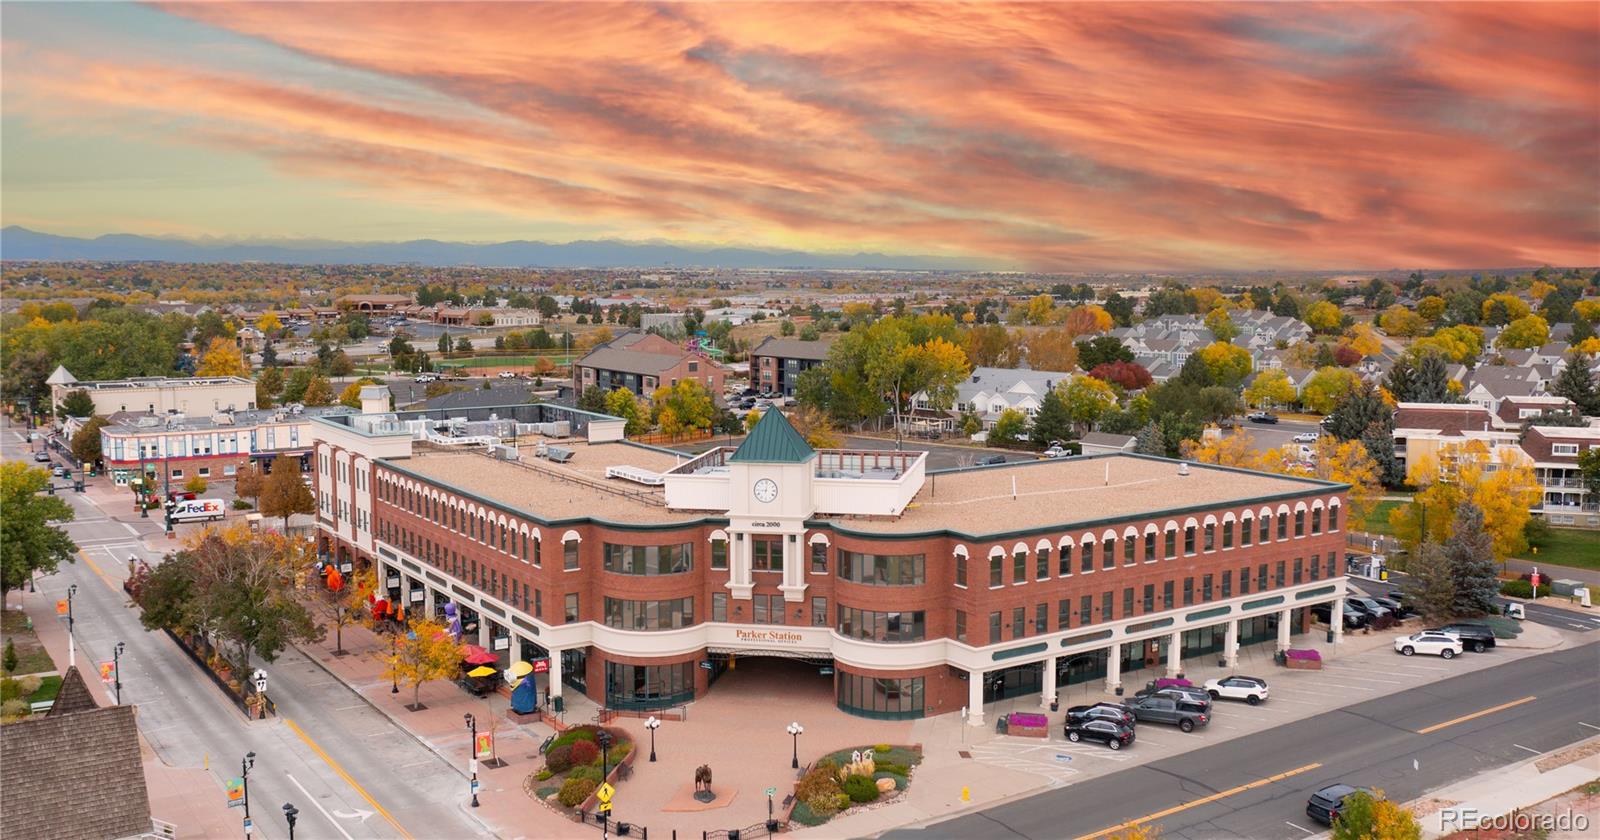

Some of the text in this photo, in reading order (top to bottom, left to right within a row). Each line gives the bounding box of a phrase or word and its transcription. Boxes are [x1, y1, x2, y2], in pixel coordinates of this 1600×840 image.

[187, 503, 219, 513] FedEx
[736, 629, 802, 641] Parker Station
